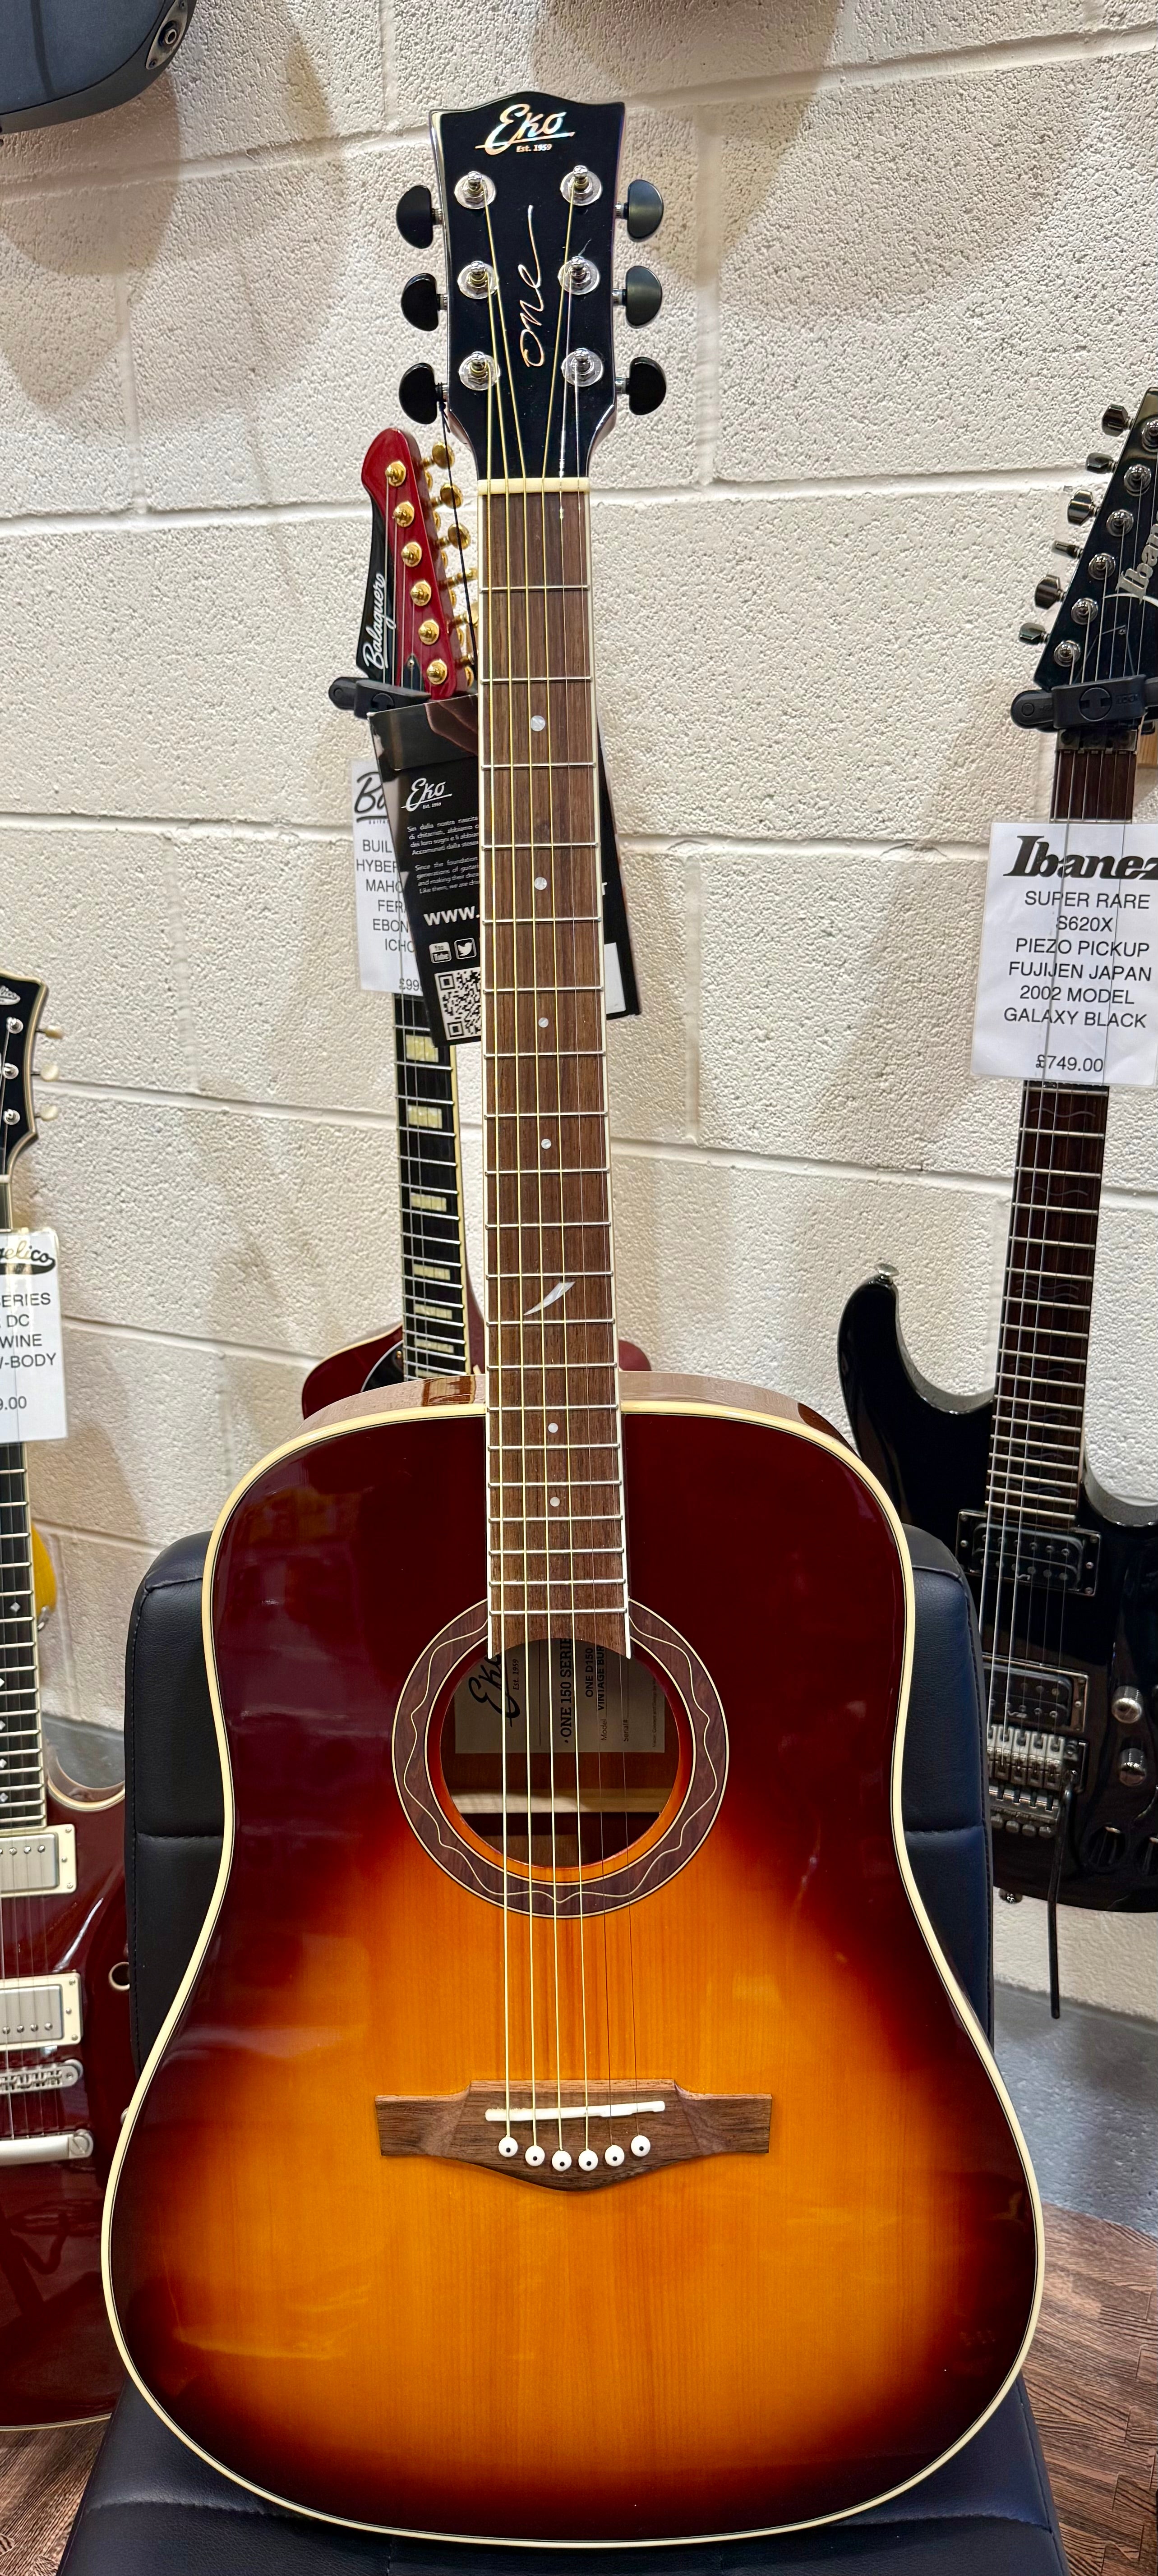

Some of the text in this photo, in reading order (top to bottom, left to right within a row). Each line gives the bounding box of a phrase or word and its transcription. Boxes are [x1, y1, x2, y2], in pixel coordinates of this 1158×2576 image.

[478, 103, 572, 155] Eko
[518, 205, 544, 367] one
[403, 777, 450, 812] Eko
[1024, 890, 1151, 909] SUPER RARE
[1056, 915, 1113, 932] S620X
[1015, 938, 1150, 957] PIEZO PICKUP
[1009, 961, 1152, 982] FUJIJEN JAPAN
[1020, 985, 1135, 1004] 2002 MODEL
[1004, 1007, 1148, 1028] GALAXY BLACK
[1035, 1054, 1104, 1072] £749.00
[7, 1314, 30, 1328] DC
[585, 1648, 594, 1697] ONE D150
[560, 1681, 572, 1704] 150
[597, 1669, 605, 1711] VINTAGE
[560, 1707, 572, 1737] ONE
